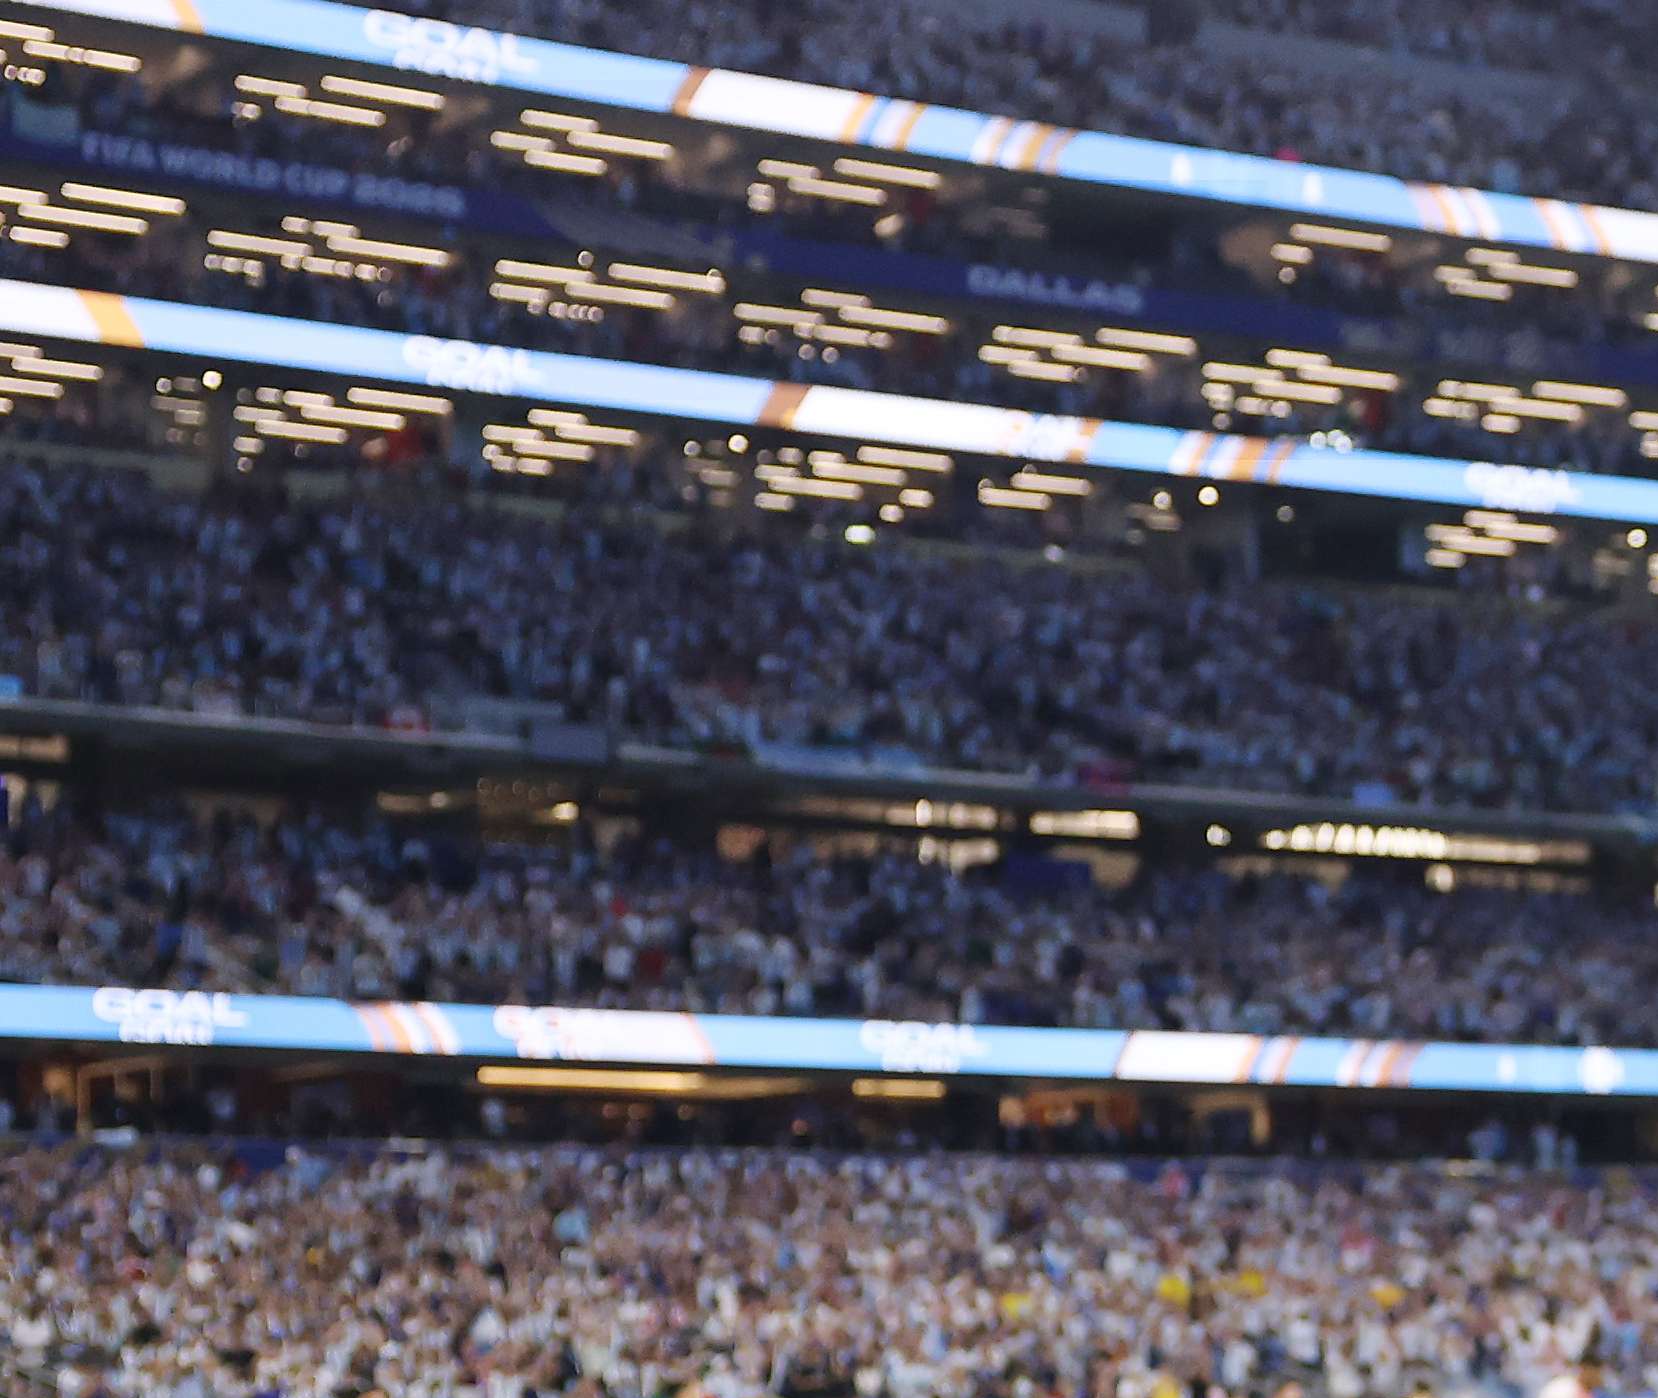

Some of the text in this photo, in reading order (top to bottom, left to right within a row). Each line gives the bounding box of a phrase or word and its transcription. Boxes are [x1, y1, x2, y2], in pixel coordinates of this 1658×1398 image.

[364, 9, 540, 75] GOAL
[160, 145, 280, 191] WORLD
[284, 162, 348, 198] CUP
[966, 265, 1145, 314] DALLAS
[92, 986, 247, 1028] GOAL
